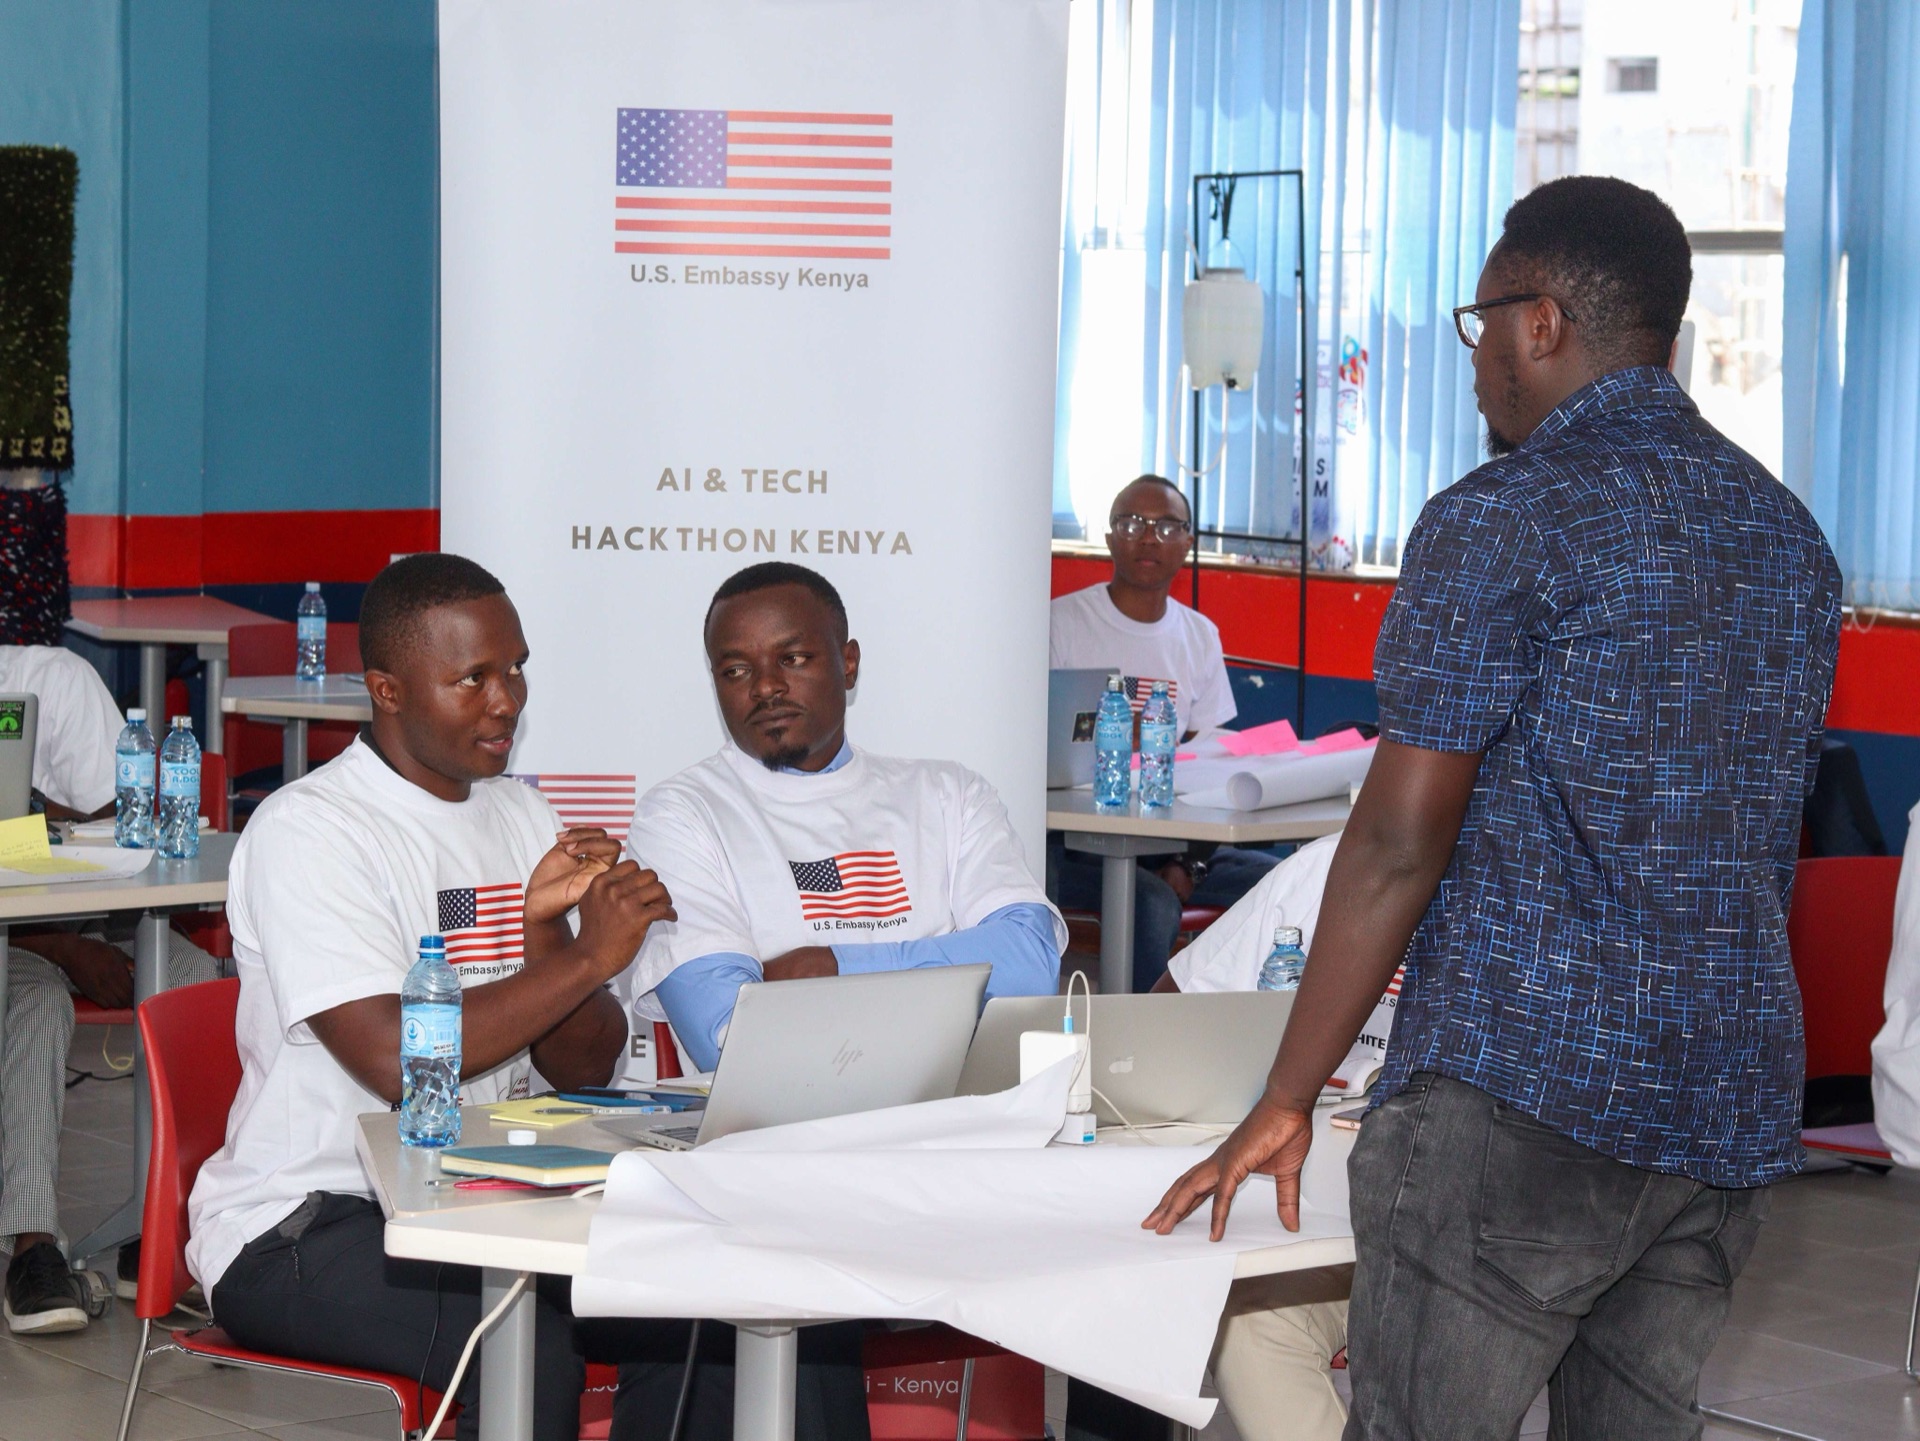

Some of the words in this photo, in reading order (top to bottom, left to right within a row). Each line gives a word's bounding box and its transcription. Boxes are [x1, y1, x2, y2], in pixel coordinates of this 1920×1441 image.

[630, 263, 676, 284] U.S.
[684, 265, 790, 291] Embassy
[798, 267, 869, 292] Kenya
[656, 467, 691, 492] AI
[703, 467, 728, 493] &
[741, 468, 828, 494] TECH
[571, 525, 776, 553] HACKTHON
[790, 529, 913, 556] KENYA
[813, 920, 834, 931] U.S.
[836, 919, 876, 931] Embassy
[876, 915, 908, 930] Kenya
[459, 964, 502, 976] Embassy
[502, 962, 524, 973] enya
[894, 1376, 959, 1399] Kenya
